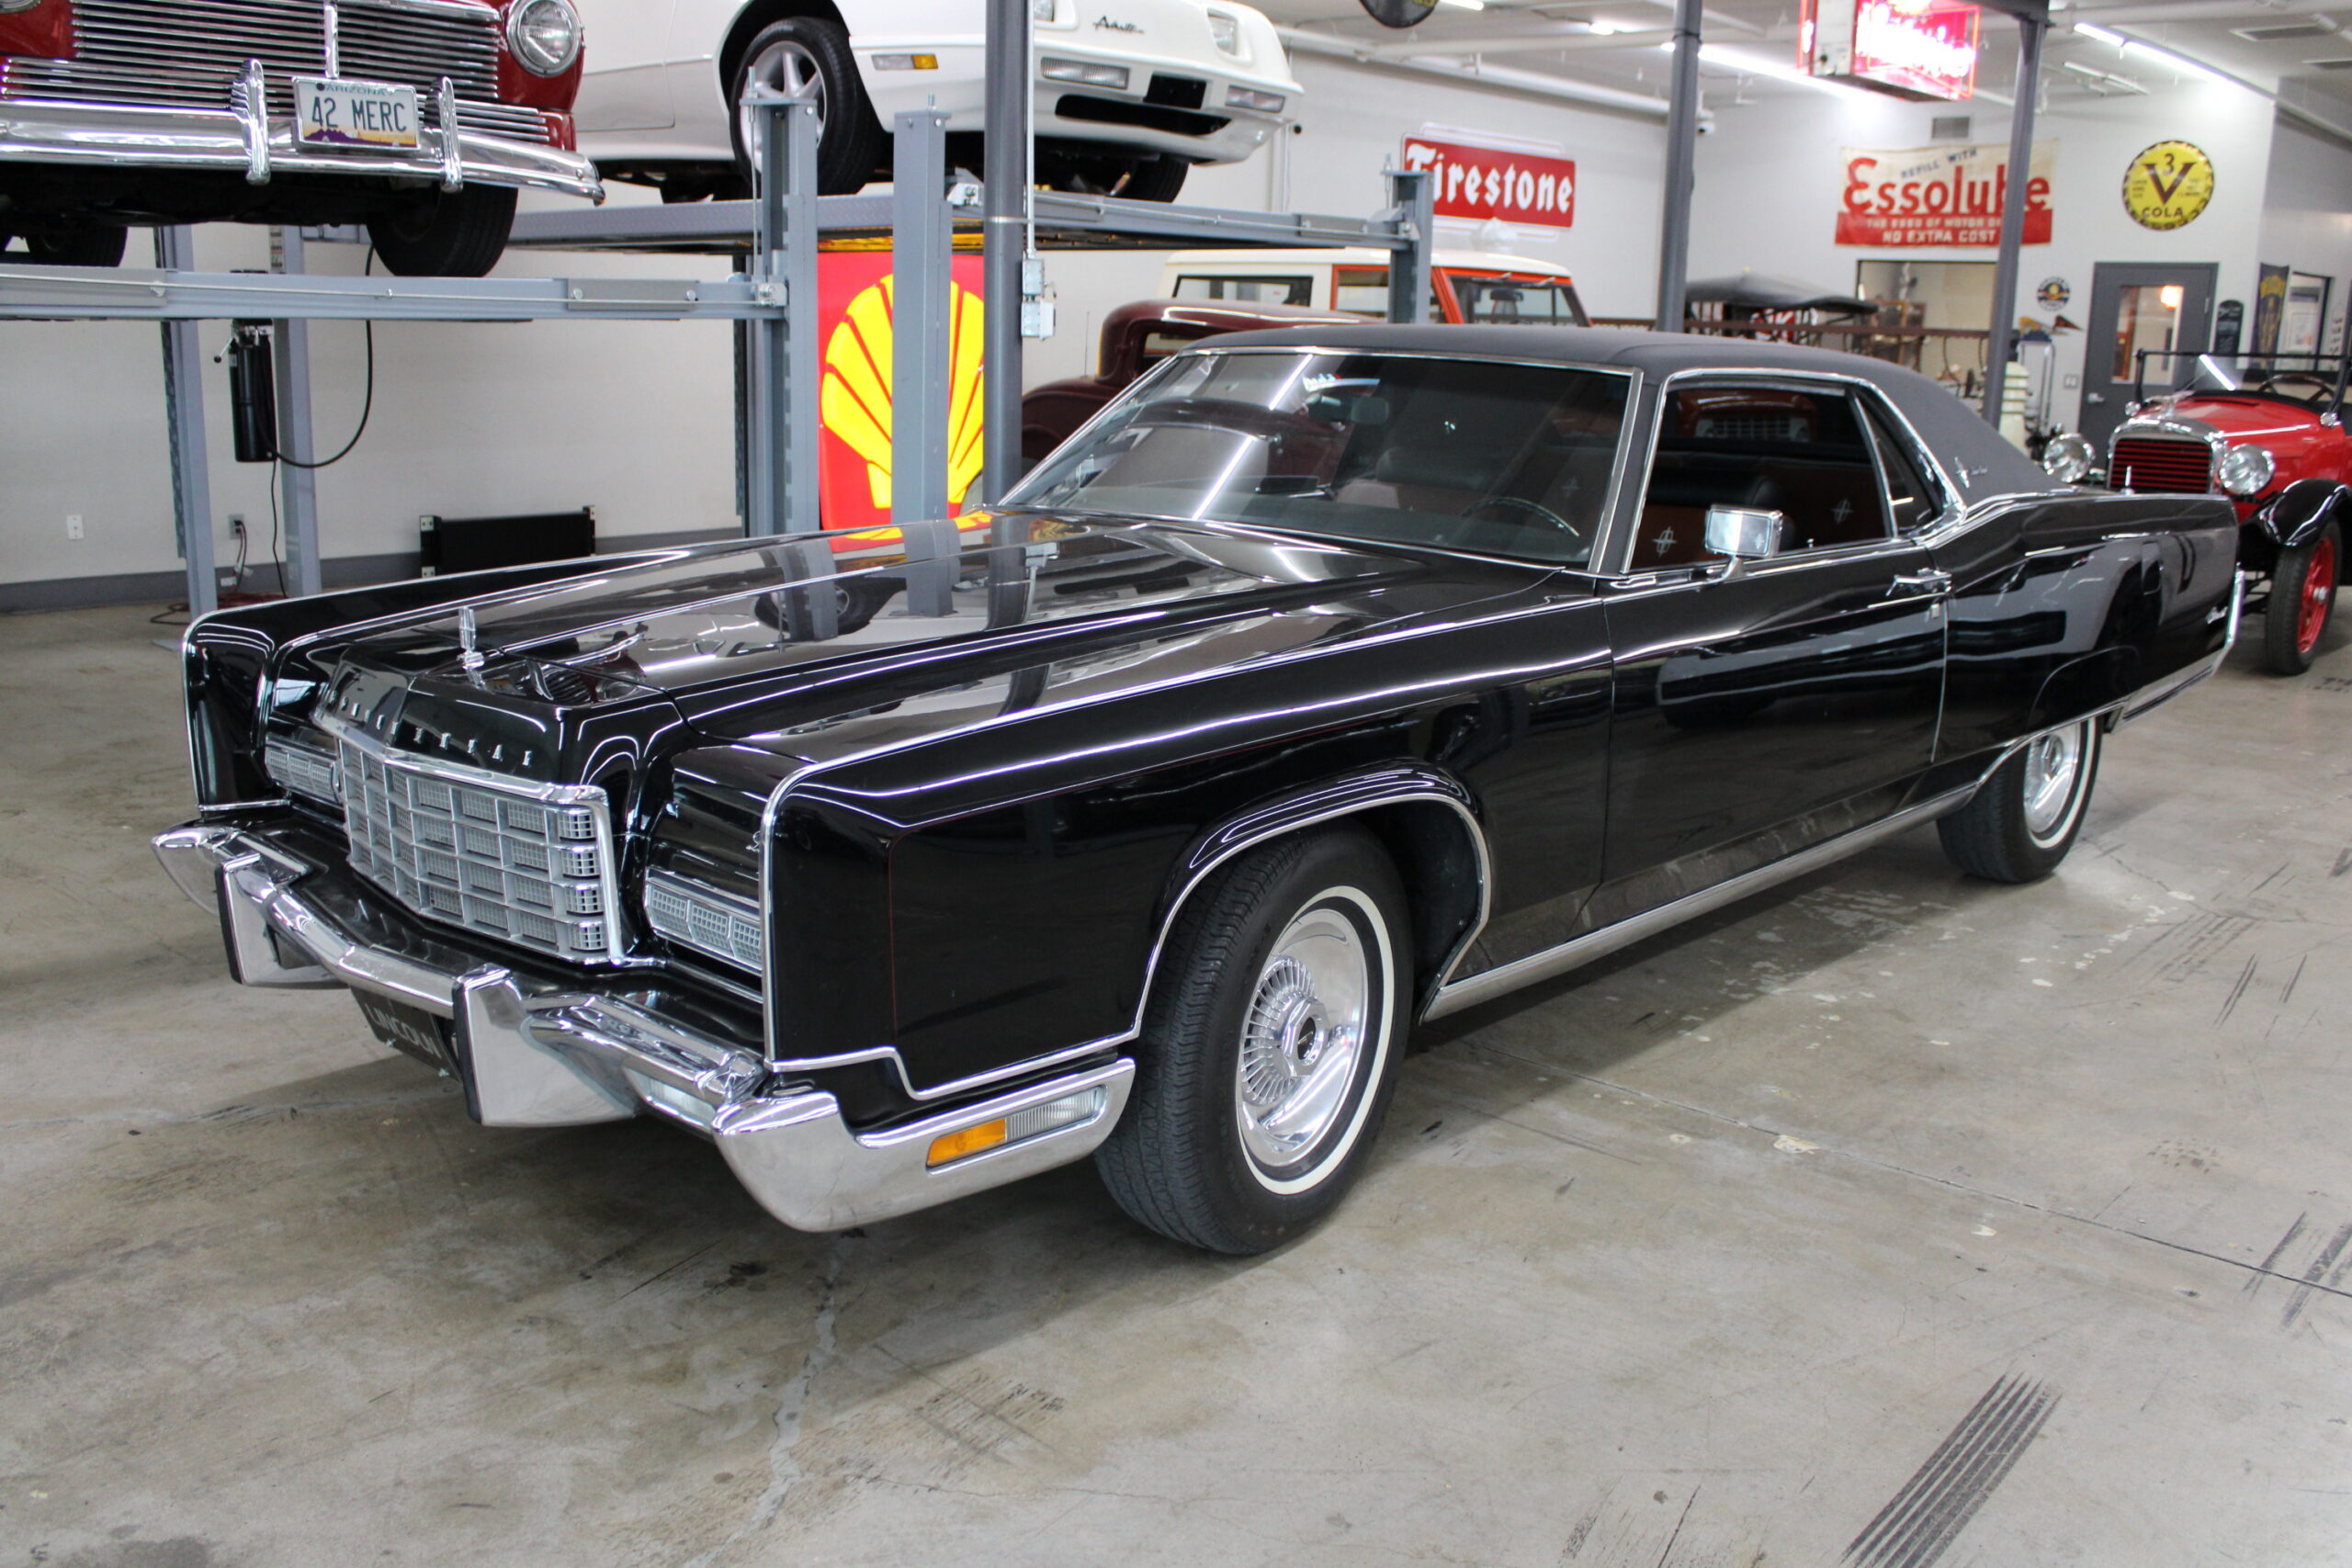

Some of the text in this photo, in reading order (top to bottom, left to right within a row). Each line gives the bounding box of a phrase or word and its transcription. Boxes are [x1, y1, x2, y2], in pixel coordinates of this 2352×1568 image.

[326, 84, 385, 96] ARIZONA
[312, 96, 407, 132] 42 MERC
[1901, 147, 1977, 178] REFILL WITH
[2162, 152, 2175, 176] 3
[2142, 162, 2197, 206] V
[2142, 207, 2184, 219] COLA
[1883, 229, 1996, 243] NO EXTRA COST
[364, 1002, 443, 1060] LINCOLN
